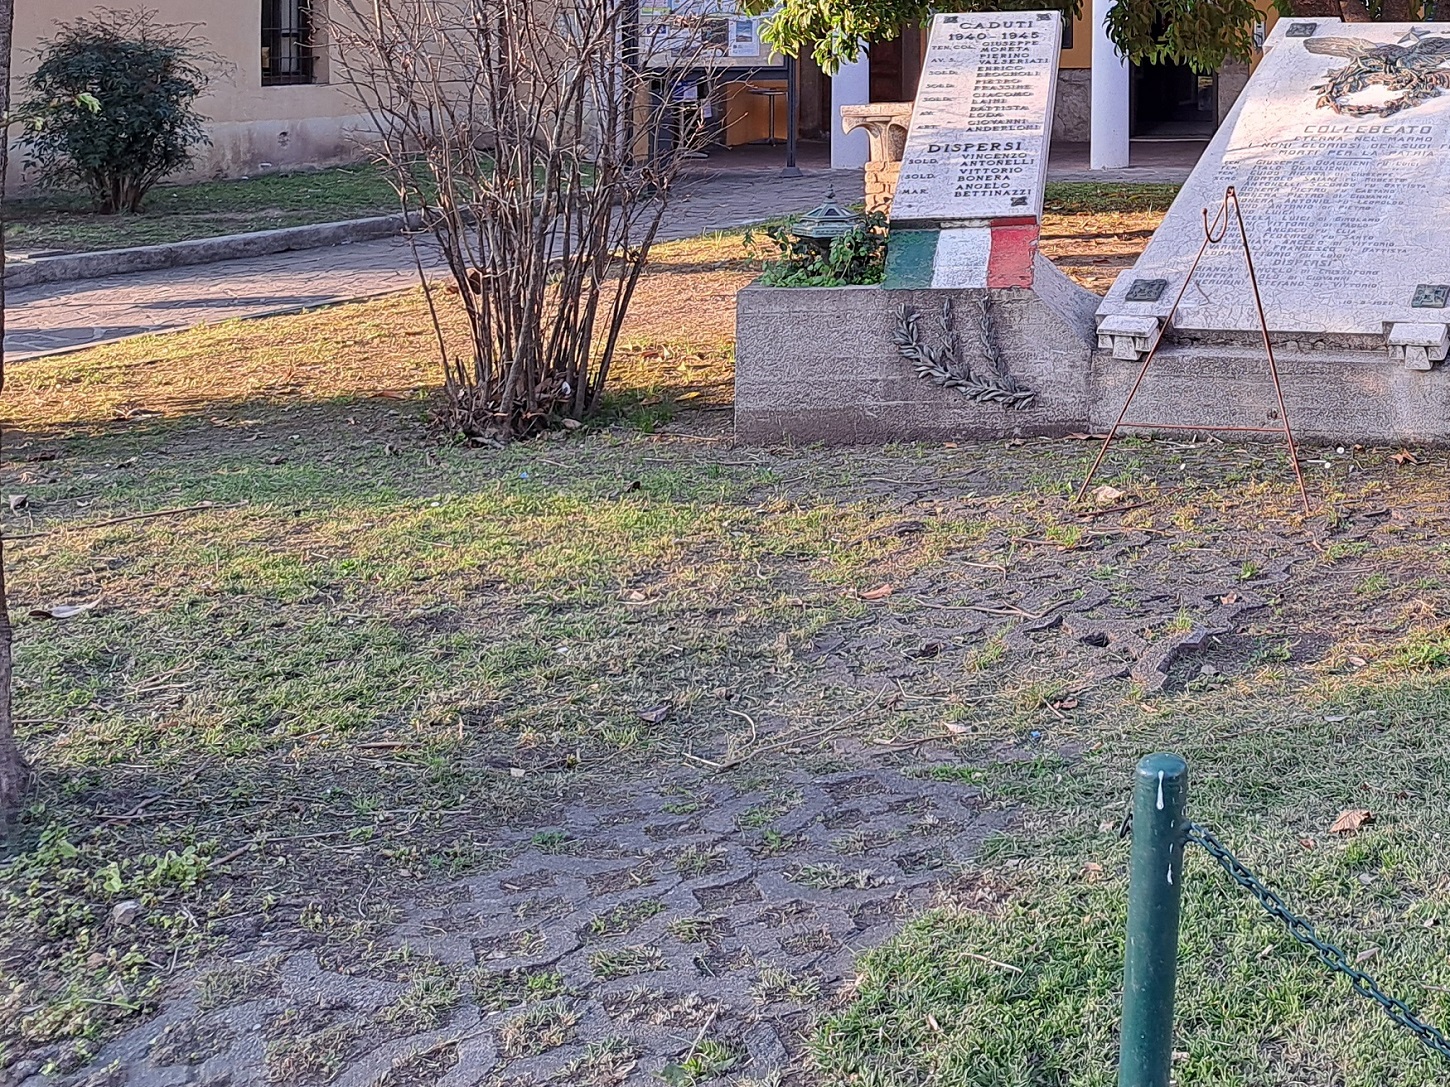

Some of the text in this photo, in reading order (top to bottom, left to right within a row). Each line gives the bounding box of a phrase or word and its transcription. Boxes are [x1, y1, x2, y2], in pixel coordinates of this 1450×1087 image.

[959, 20, 1034, 30] CADUTI
[1304, 125, 1432, 134] COLLEBEATO
[927, 142, 1022, 154] DISPERSI
[960, 158, 1034, 166] ANTONELLI
[954, 188, 1031, 198] BETTINAZZI
